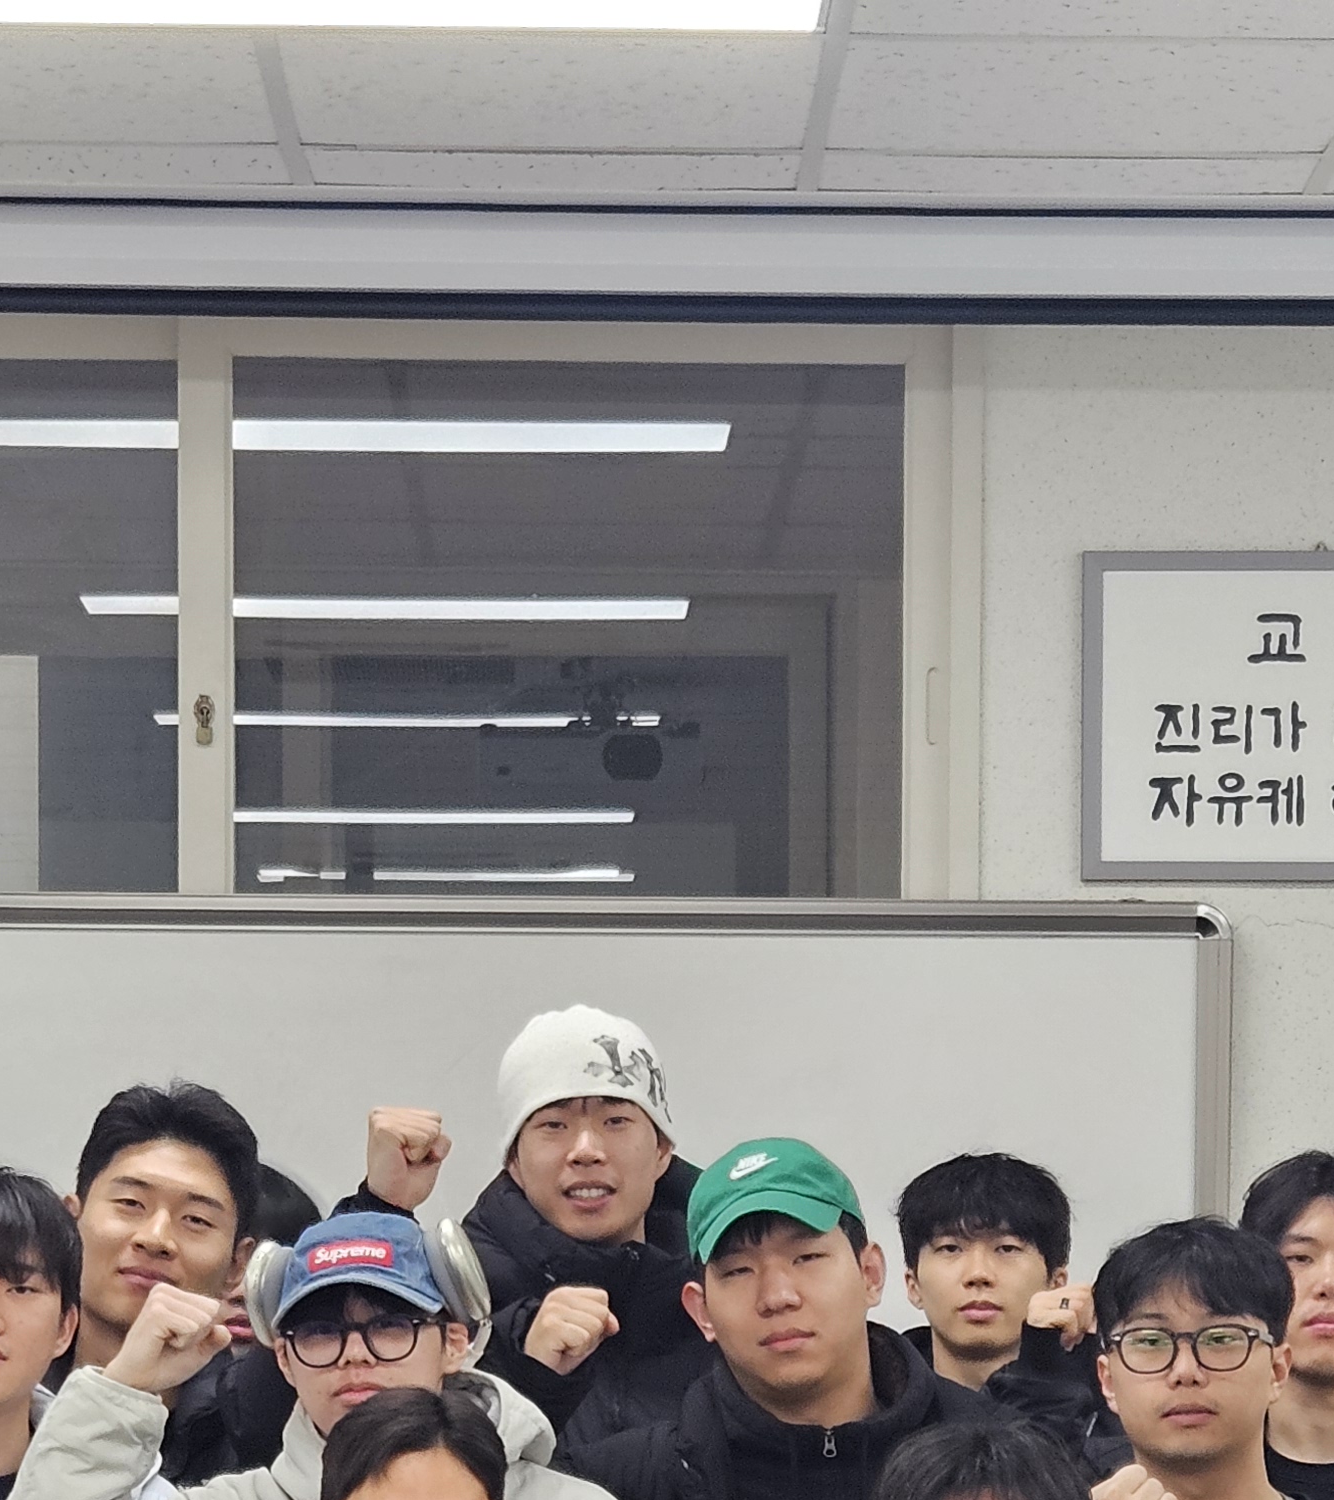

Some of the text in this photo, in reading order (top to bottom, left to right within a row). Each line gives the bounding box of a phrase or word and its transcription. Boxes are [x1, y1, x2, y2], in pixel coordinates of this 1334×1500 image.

[1248, 614, 1305, 663] 교
[1155, 701, 1306, 754] 진리가
[1149, 773, 1304, 826] 자유케
[314, 1245, 387, 1265] Supreme
